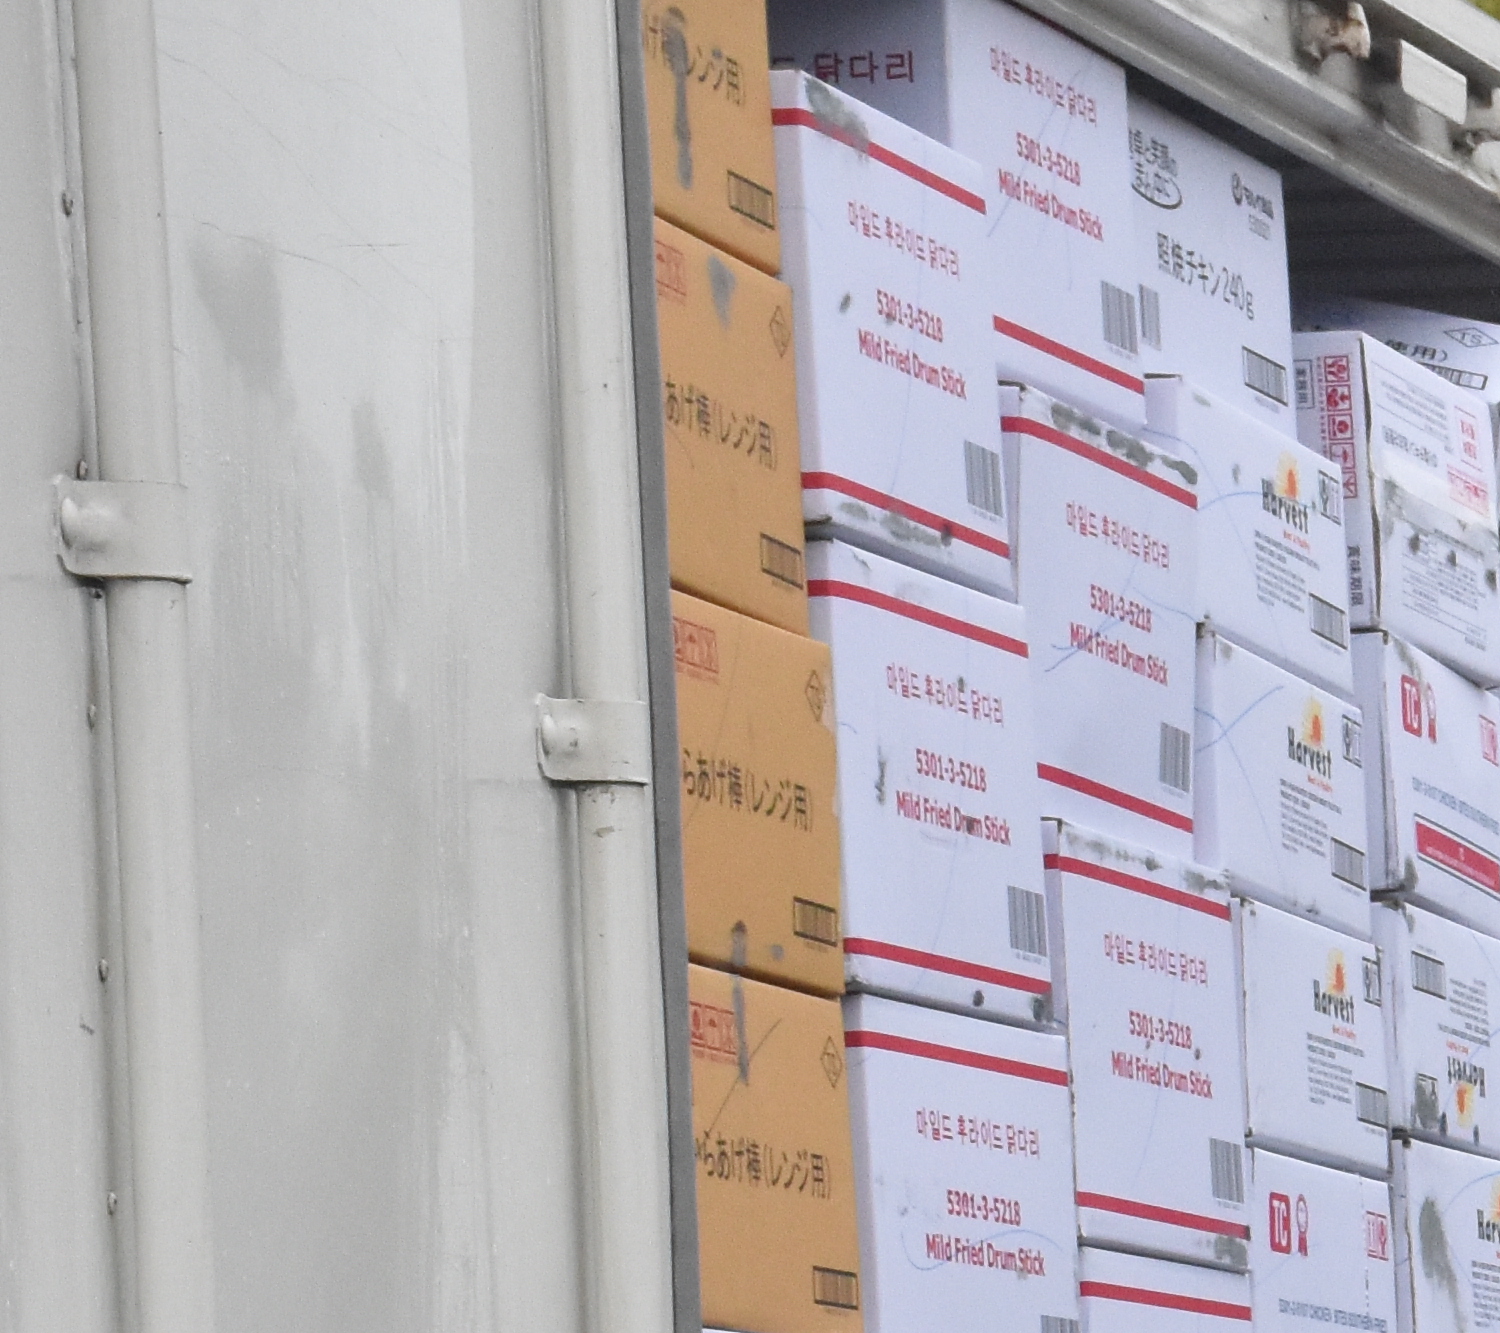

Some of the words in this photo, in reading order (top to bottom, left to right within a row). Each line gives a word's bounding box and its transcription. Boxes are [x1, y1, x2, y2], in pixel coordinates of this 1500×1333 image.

[999, 168, 1023, 202] Mild
[1024, 180, 1051, 215] Fried
[1053, 194, 1078, 230] Drum
[1080, 208, 1104, 241] Stick
[857, 328, 882, 363] Mild
[883, 340, 912, 376] Fried
[913, 353, 940, 389] Drum
[942, 365, 967, 400] Stick
[1070, 622, 1093, 654] Mild
[1094, 631, 1119, 665] Fried
[1121, 643, 1145, 676] Drum
[1146, 654, 1169, 686] Stick
[1287, 725, 1334, 778] Harvest
[896, 790, 922, 822] Mild
[924, 797, 954, 830] Fried
[956, 806, 983, 838] Drum
[985, 815, 1012, 846] Stick
[1313, 979, 1355, 1025] Harvest
[1110, 1051, 1134, 1080] Mild
[1135, 1057, 1162, 1088] Fried
[1163, 1064, 1188, 1093] Drum
[1190, 1070, 1214, 1099] Stick
[925, 1234, 953, 1262] Mild
[954, 1238, 986, 1267] Fried
[988, 1242, 1017, 1272] Drum
[1019, 1247, 1047, 1278] Stick
